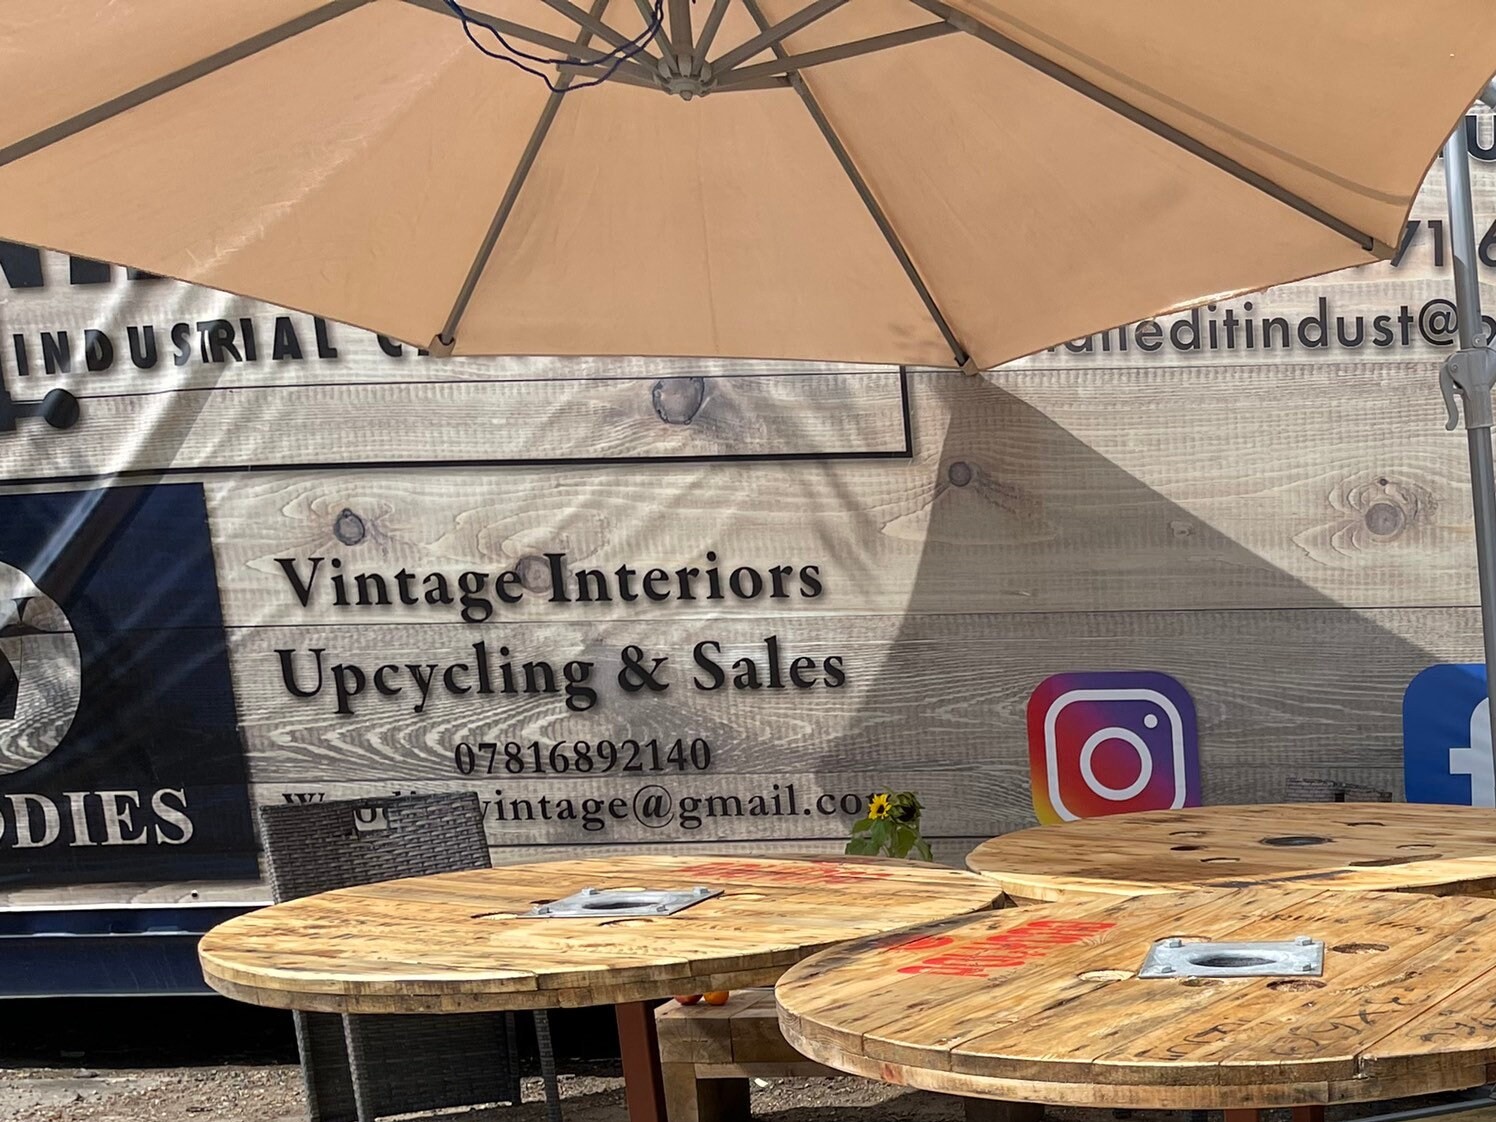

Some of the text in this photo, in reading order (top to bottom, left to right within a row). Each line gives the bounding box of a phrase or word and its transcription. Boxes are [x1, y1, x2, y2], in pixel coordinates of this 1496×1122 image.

[12, 316, 338, 376] INDUSTRIAL
[274, 551, 822, 623] Vintage Interiors
[274, 635, 847, 714] Upcycling & Sales
[454, 738, 711, 775] 07816892140
[0, 788, 194, 848] DIES
